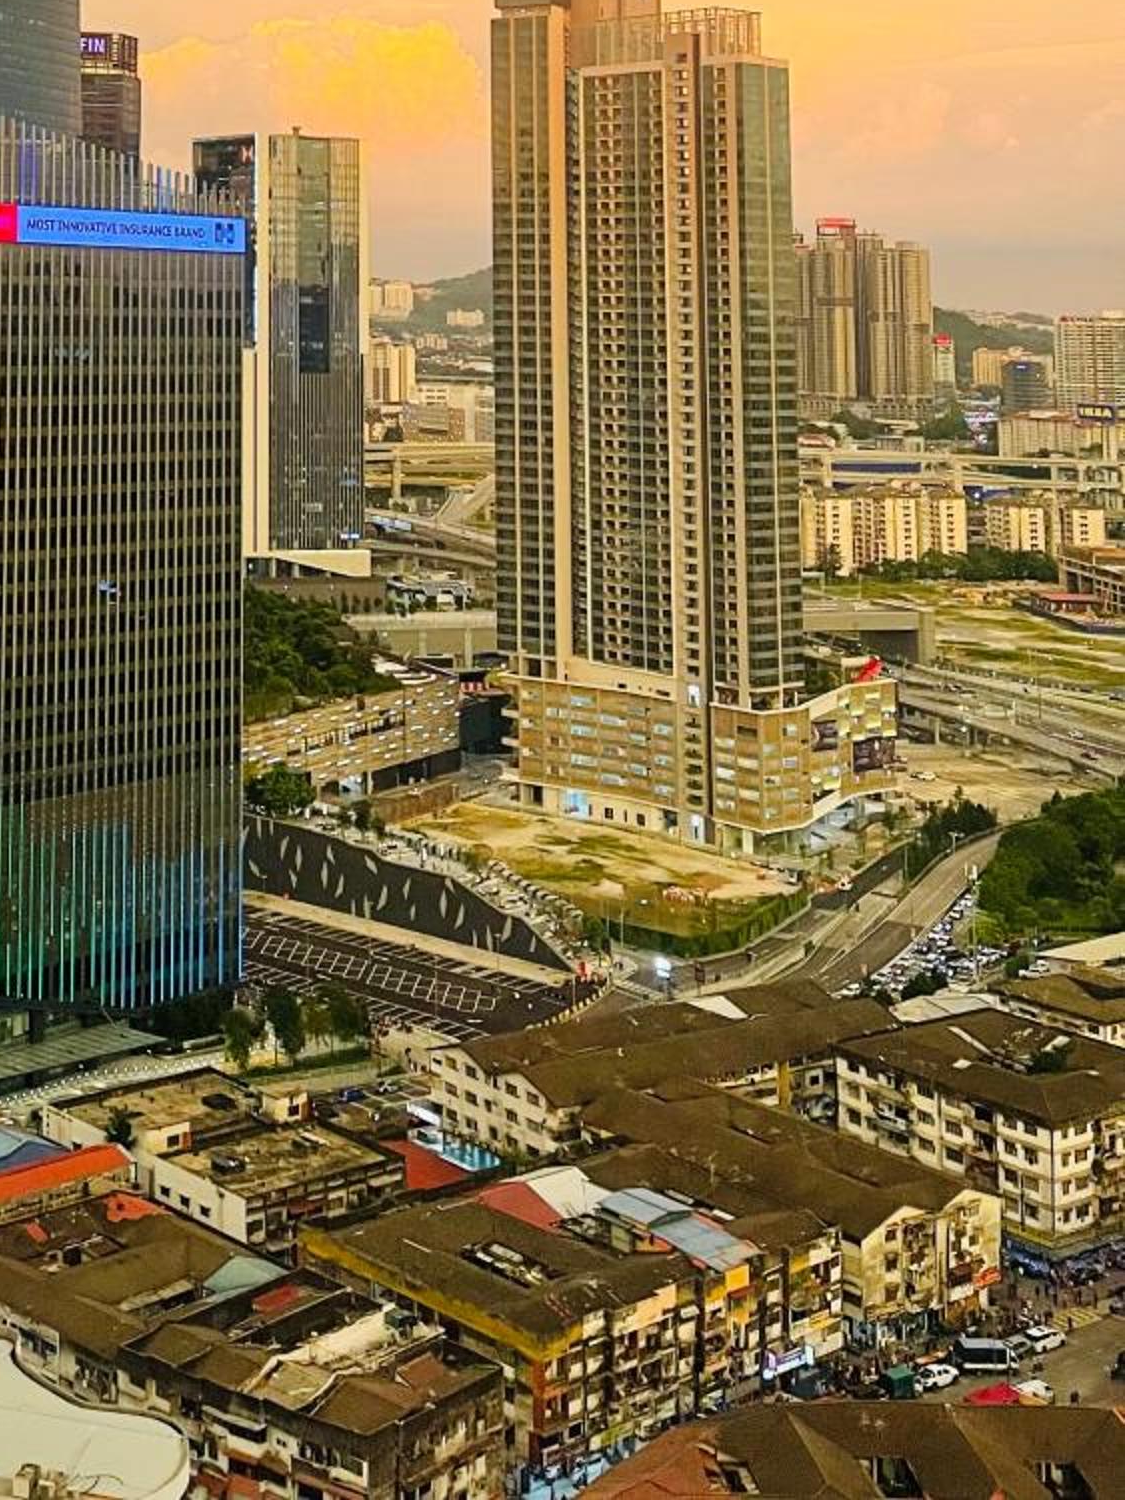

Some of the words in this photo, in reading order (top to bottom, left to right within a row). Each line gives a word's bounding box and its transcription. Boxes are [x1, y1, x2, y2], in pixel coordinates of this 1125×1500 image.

[27, 217, 55, 231] MOST
[58, 219, 117, 234] INNOVATIVE
[119, 222, 172, 237] INSURANCE
[174, 225, 206, 239] BRAND
